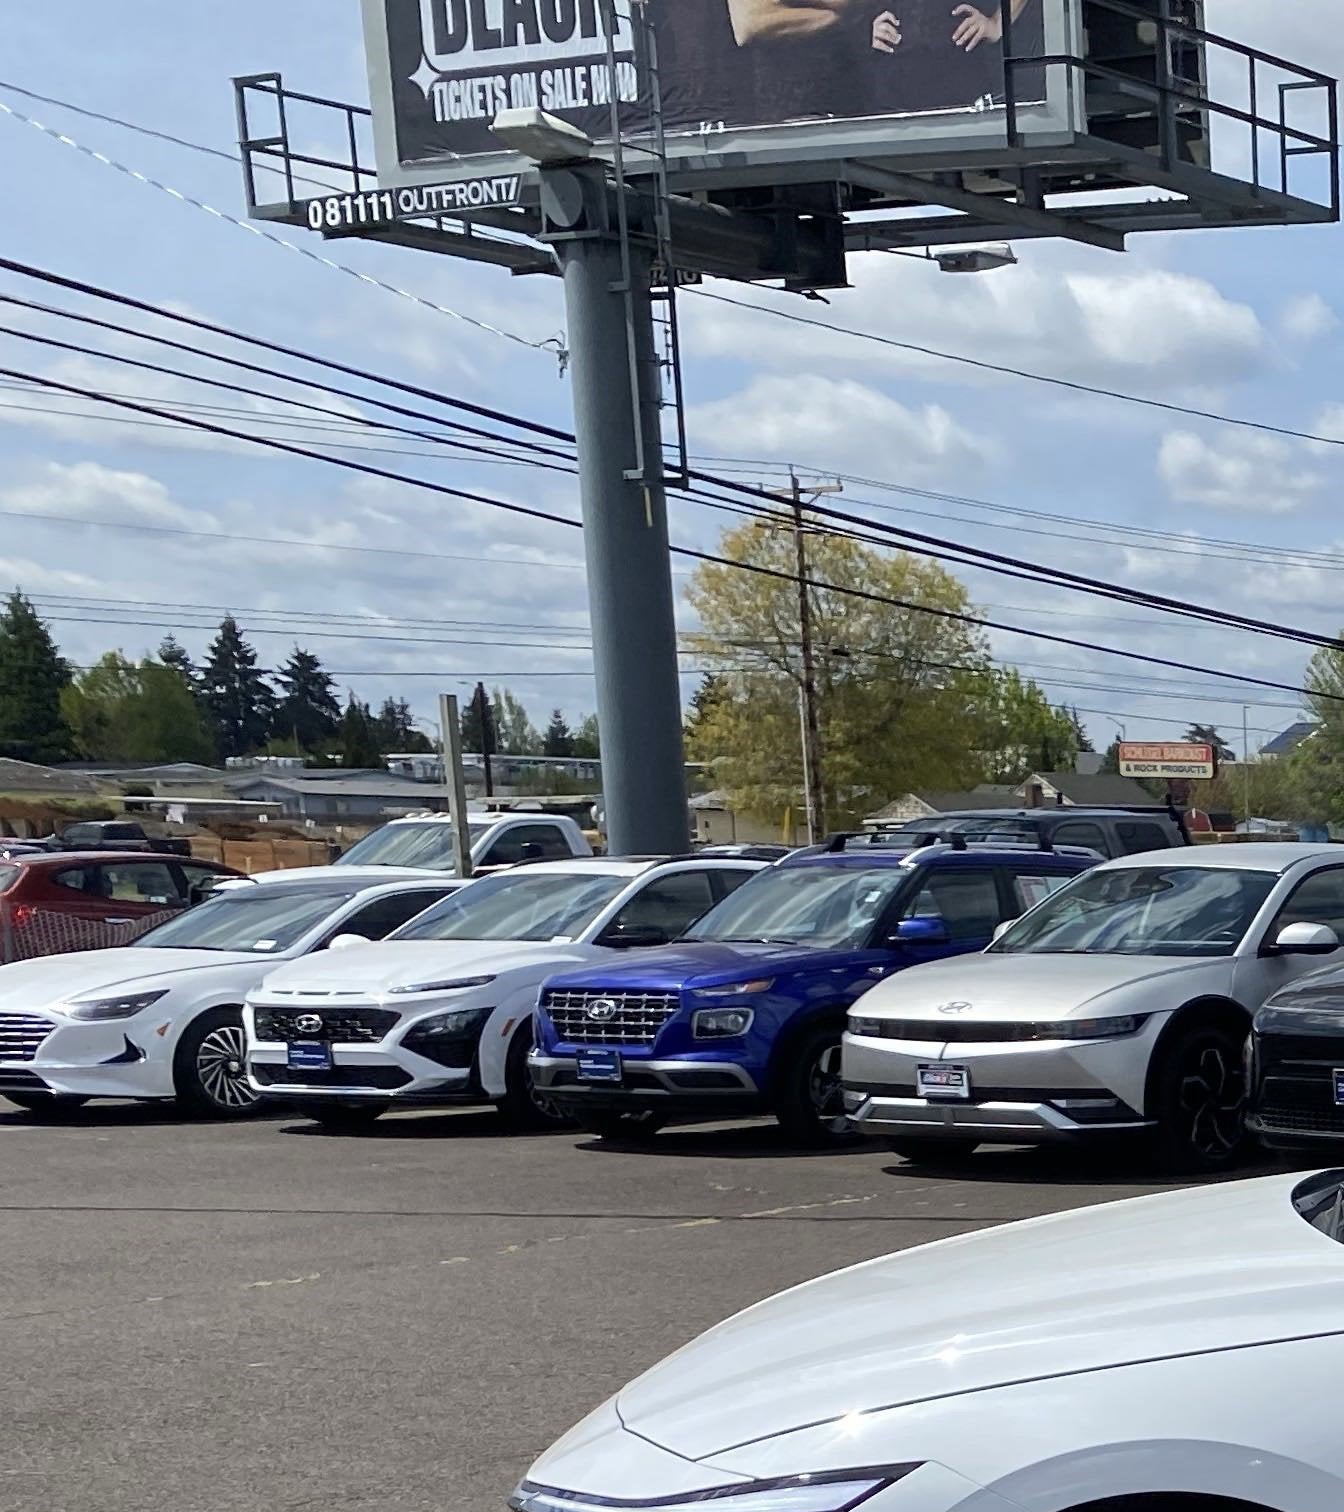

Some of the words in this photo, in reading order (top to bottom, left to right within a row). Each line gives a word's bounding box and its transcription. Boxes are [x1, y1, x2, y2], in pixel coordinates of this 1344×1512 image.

[433, 75, 507, 122] TICKETS
[510, 72, 538, 109] ON
[541, 66, 588, 110] SALE
[308, 192, 394, 229] 081111
